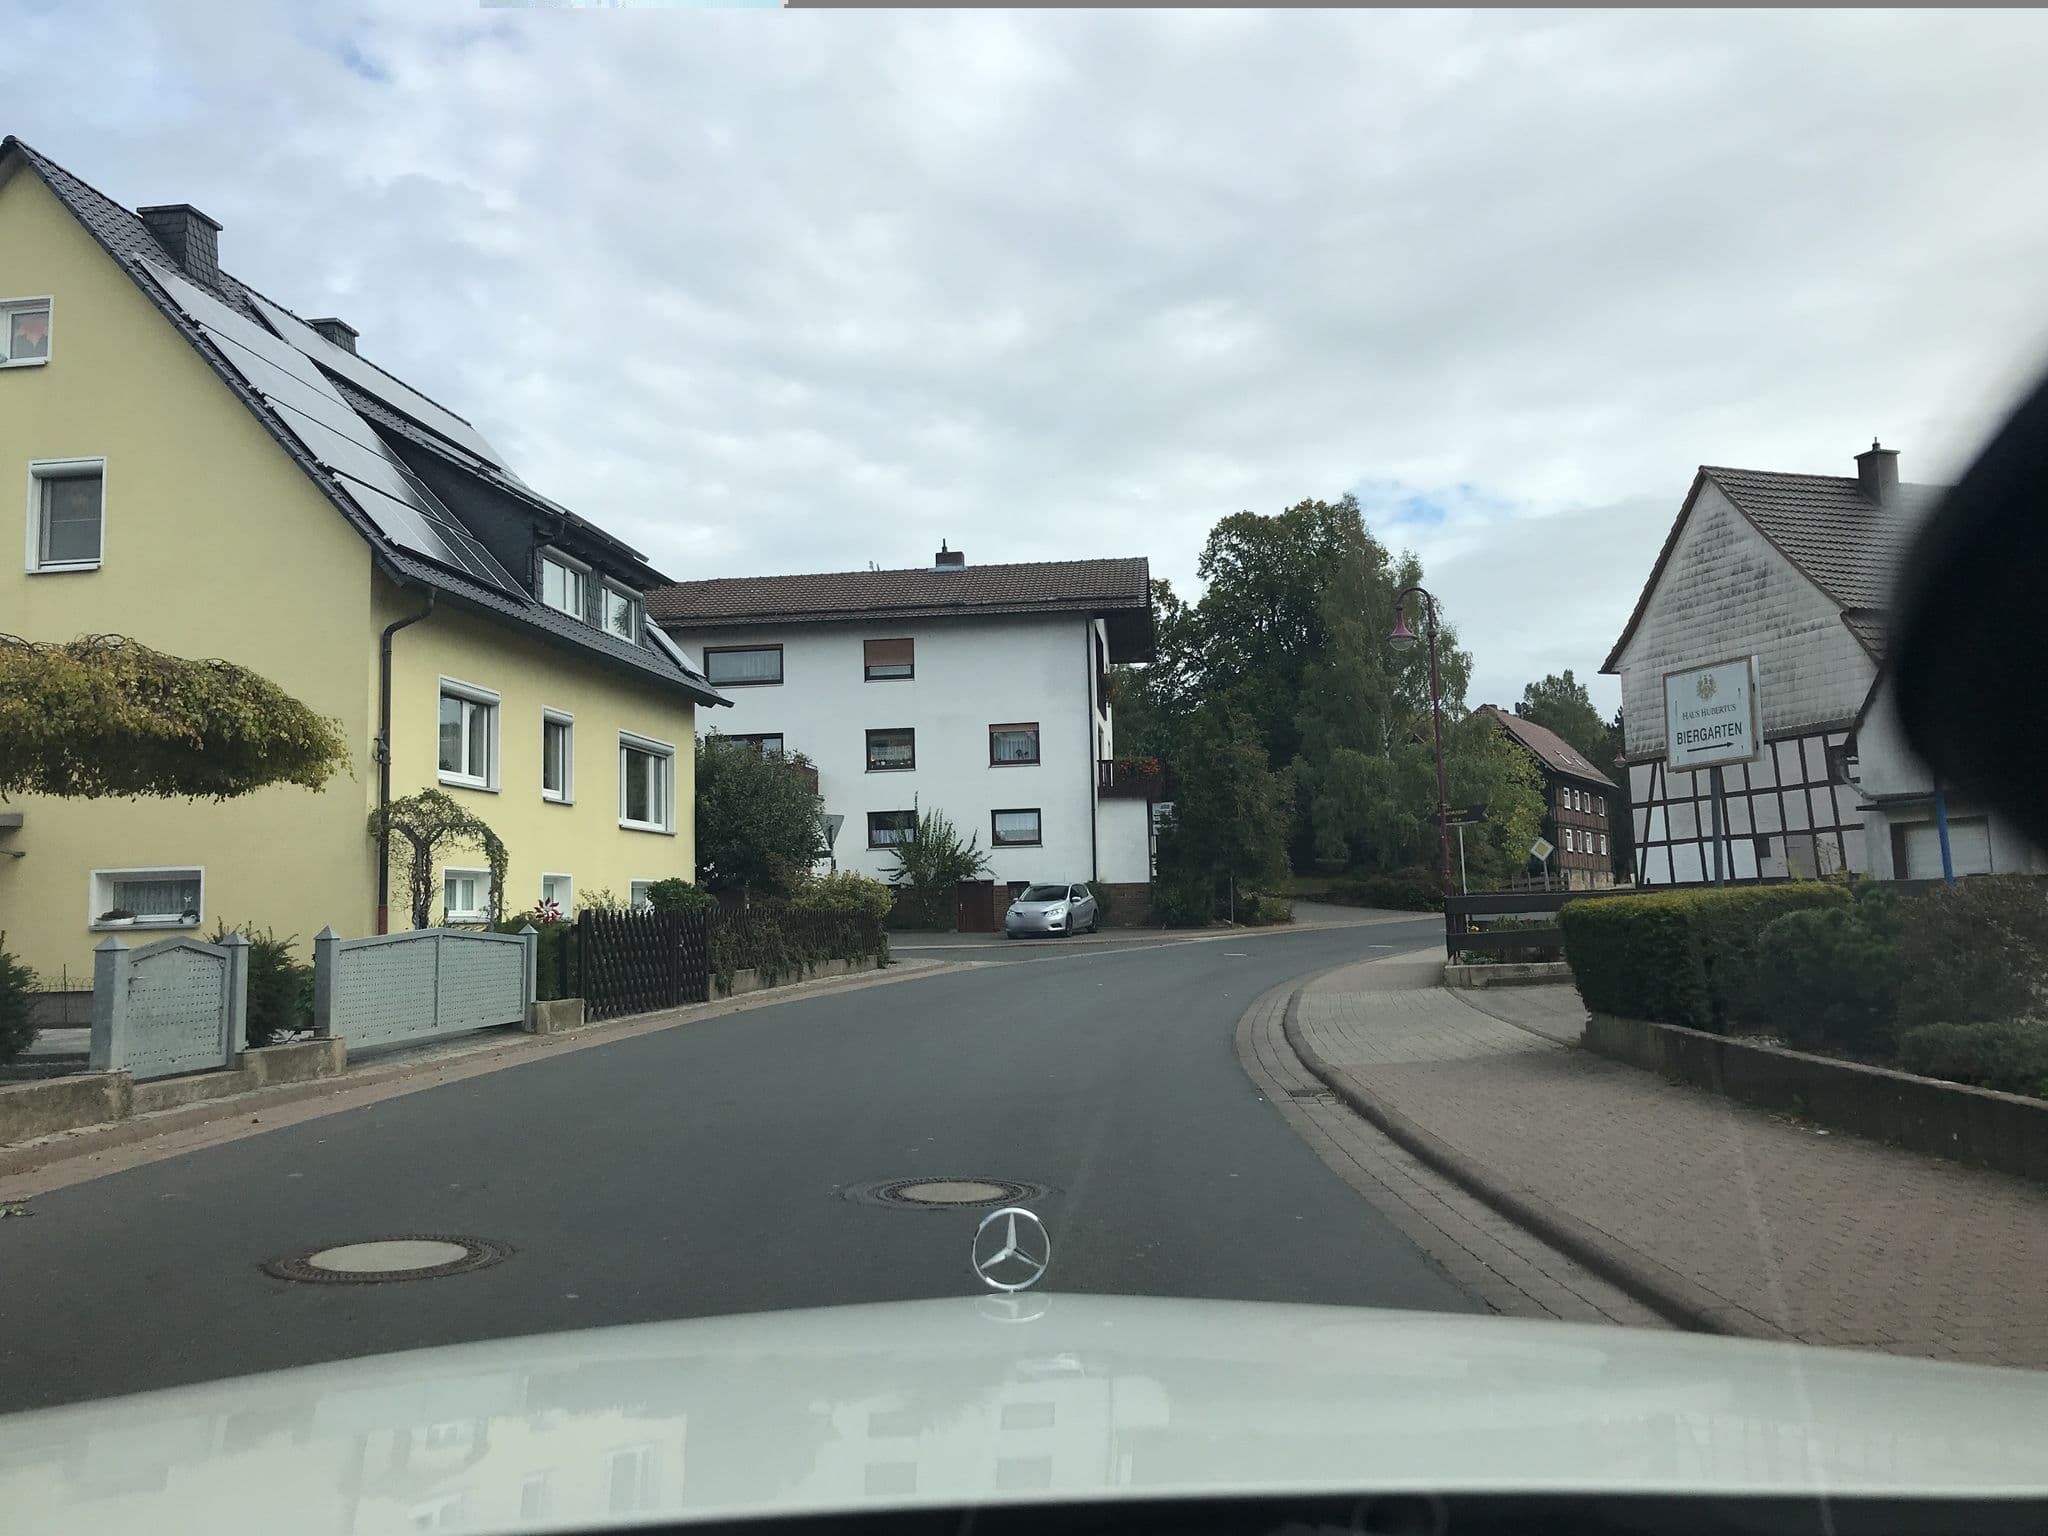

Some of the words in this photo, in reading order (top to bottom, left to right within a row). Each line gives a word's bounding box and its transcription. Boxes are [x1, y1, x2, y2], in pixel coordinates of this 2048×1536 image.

[1682, 710, 1701, 720] HAUS
[1701, 704, 1736, 717] HUBERTUS
[1677, 722, 1742, 745] BIERGARTEN
